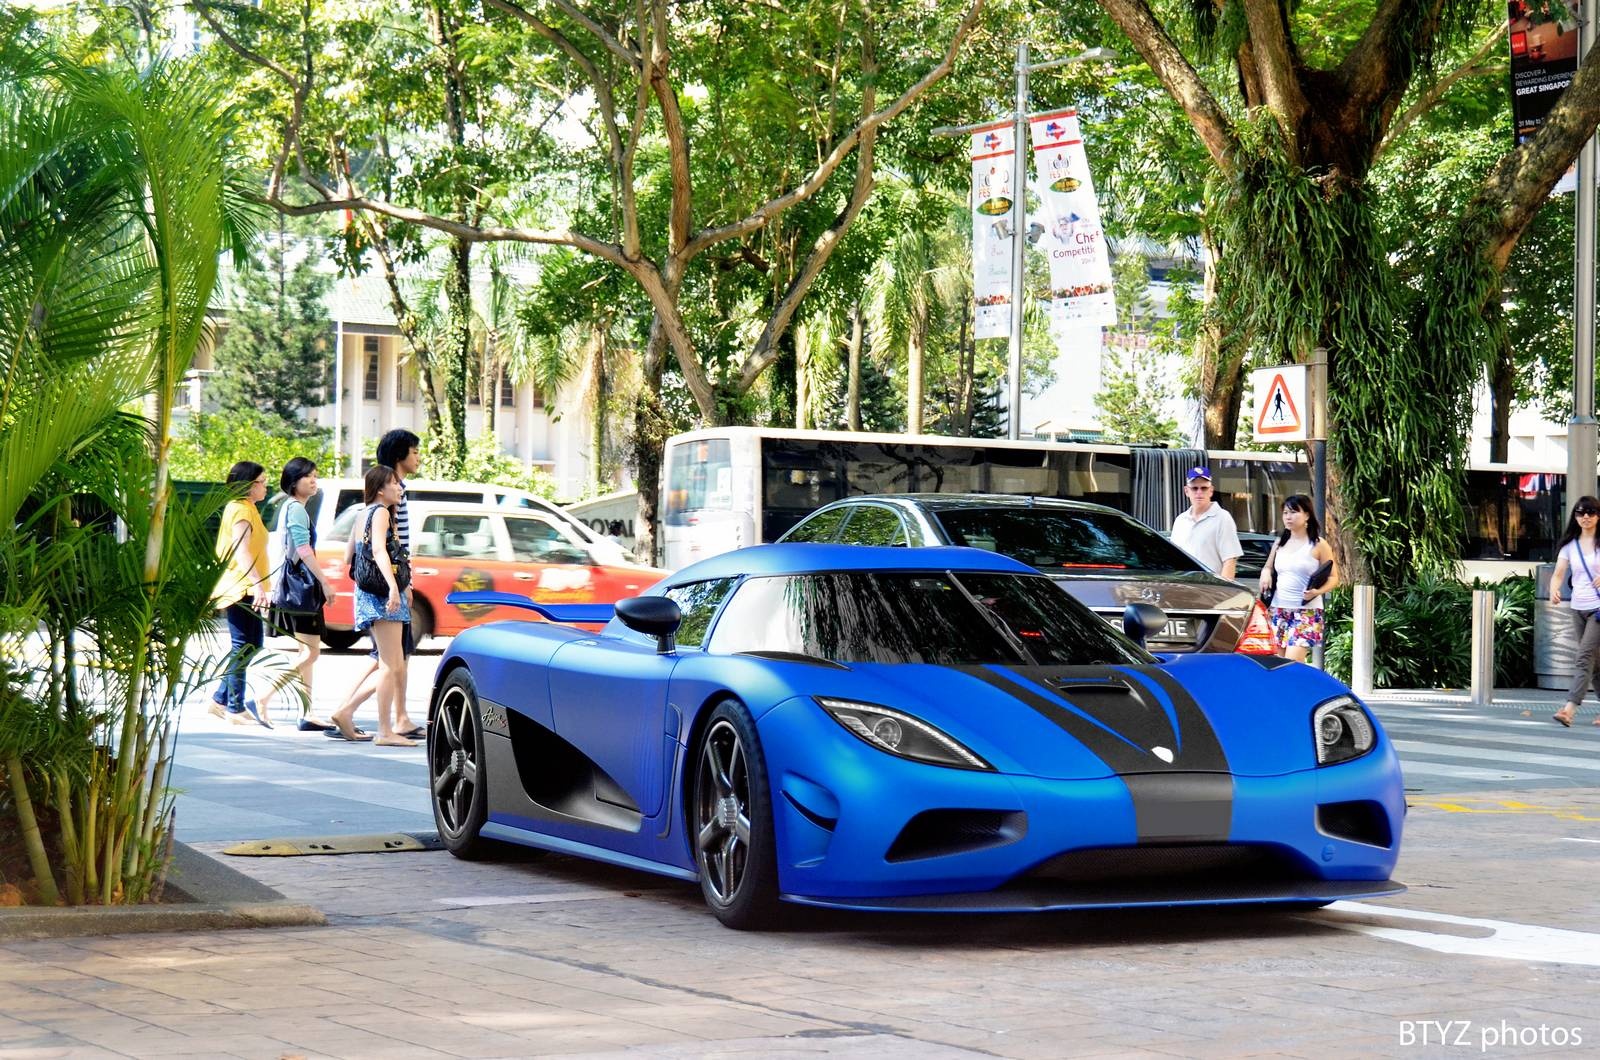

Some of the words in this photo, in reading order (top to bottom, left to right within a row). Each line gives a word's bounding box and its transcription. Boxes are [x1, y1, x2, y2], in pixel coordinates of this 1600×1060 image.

[1515, 70, 1542, 79] DISCOVER
[1515, 76, 1547, 87] REWARDING
[1548, 71, 1577, 82] EXPERIENC
[1516, 85, 1537, 96] GREAT
[1539, 80, 1570, 92] SINGAPOR
